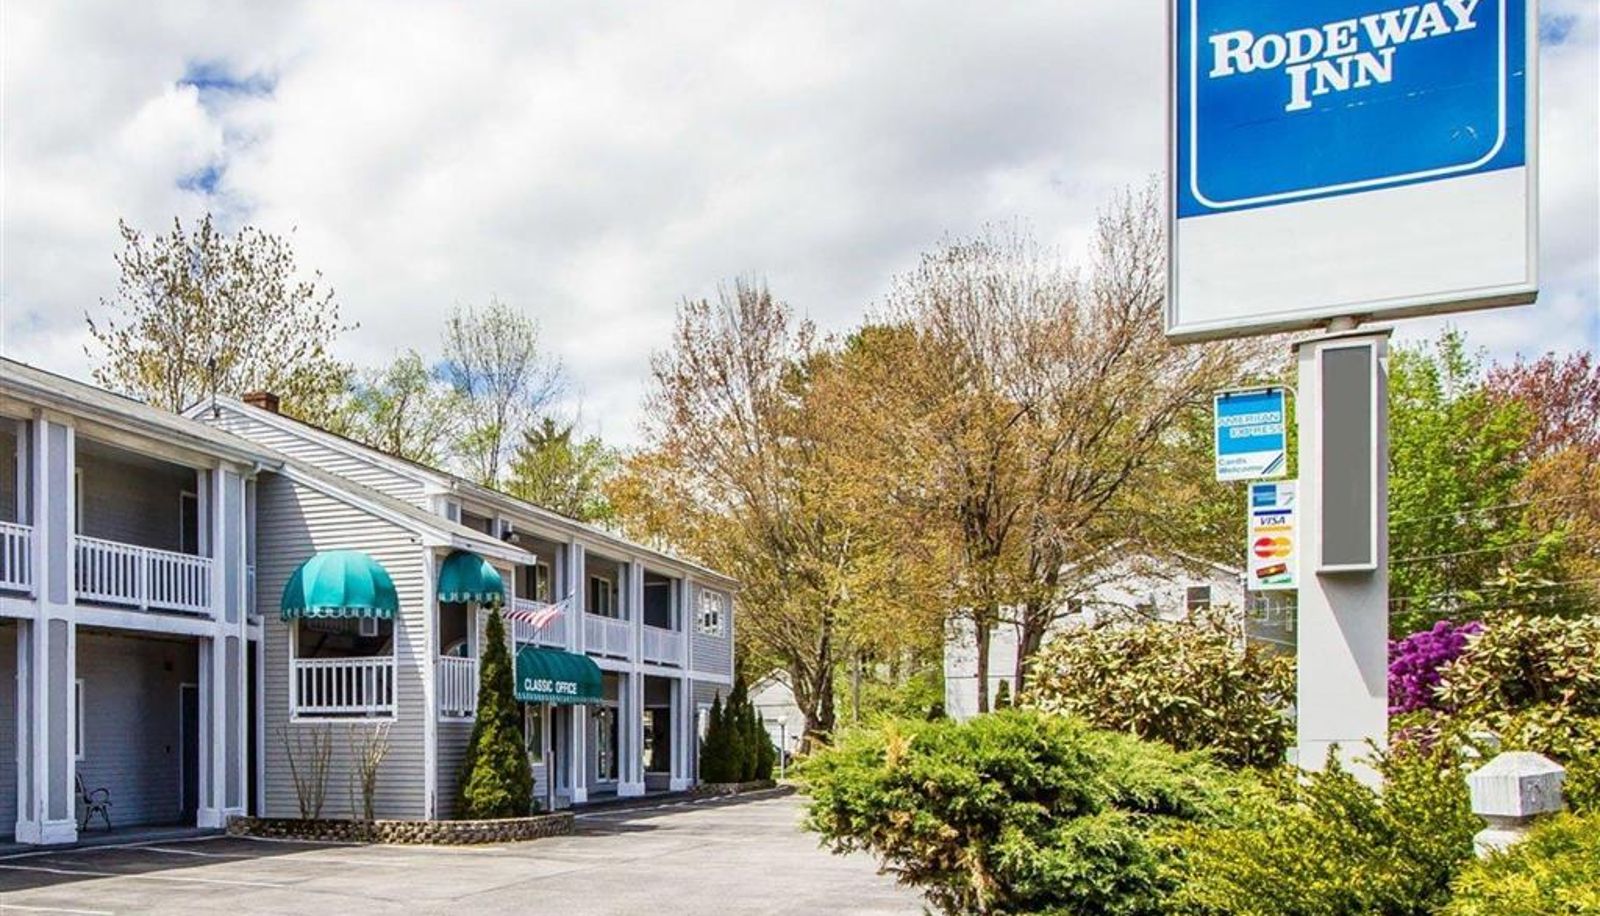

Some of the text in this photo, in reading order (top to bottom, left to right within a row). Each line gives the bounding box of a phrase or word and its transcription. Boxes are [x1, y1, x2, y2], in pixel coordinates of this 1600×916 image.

[1209, 0, 1481, 78] RODEWAY
[1285, 47, 1396, 112] INN
[1218, 413, 1279, 425] AMERICAN
[1232, 425, 1284, 436] EXPRESS
[1260, 516, 1286, 525] VISA
[524, 677, 577, 694] CLASSIC OFFICE
